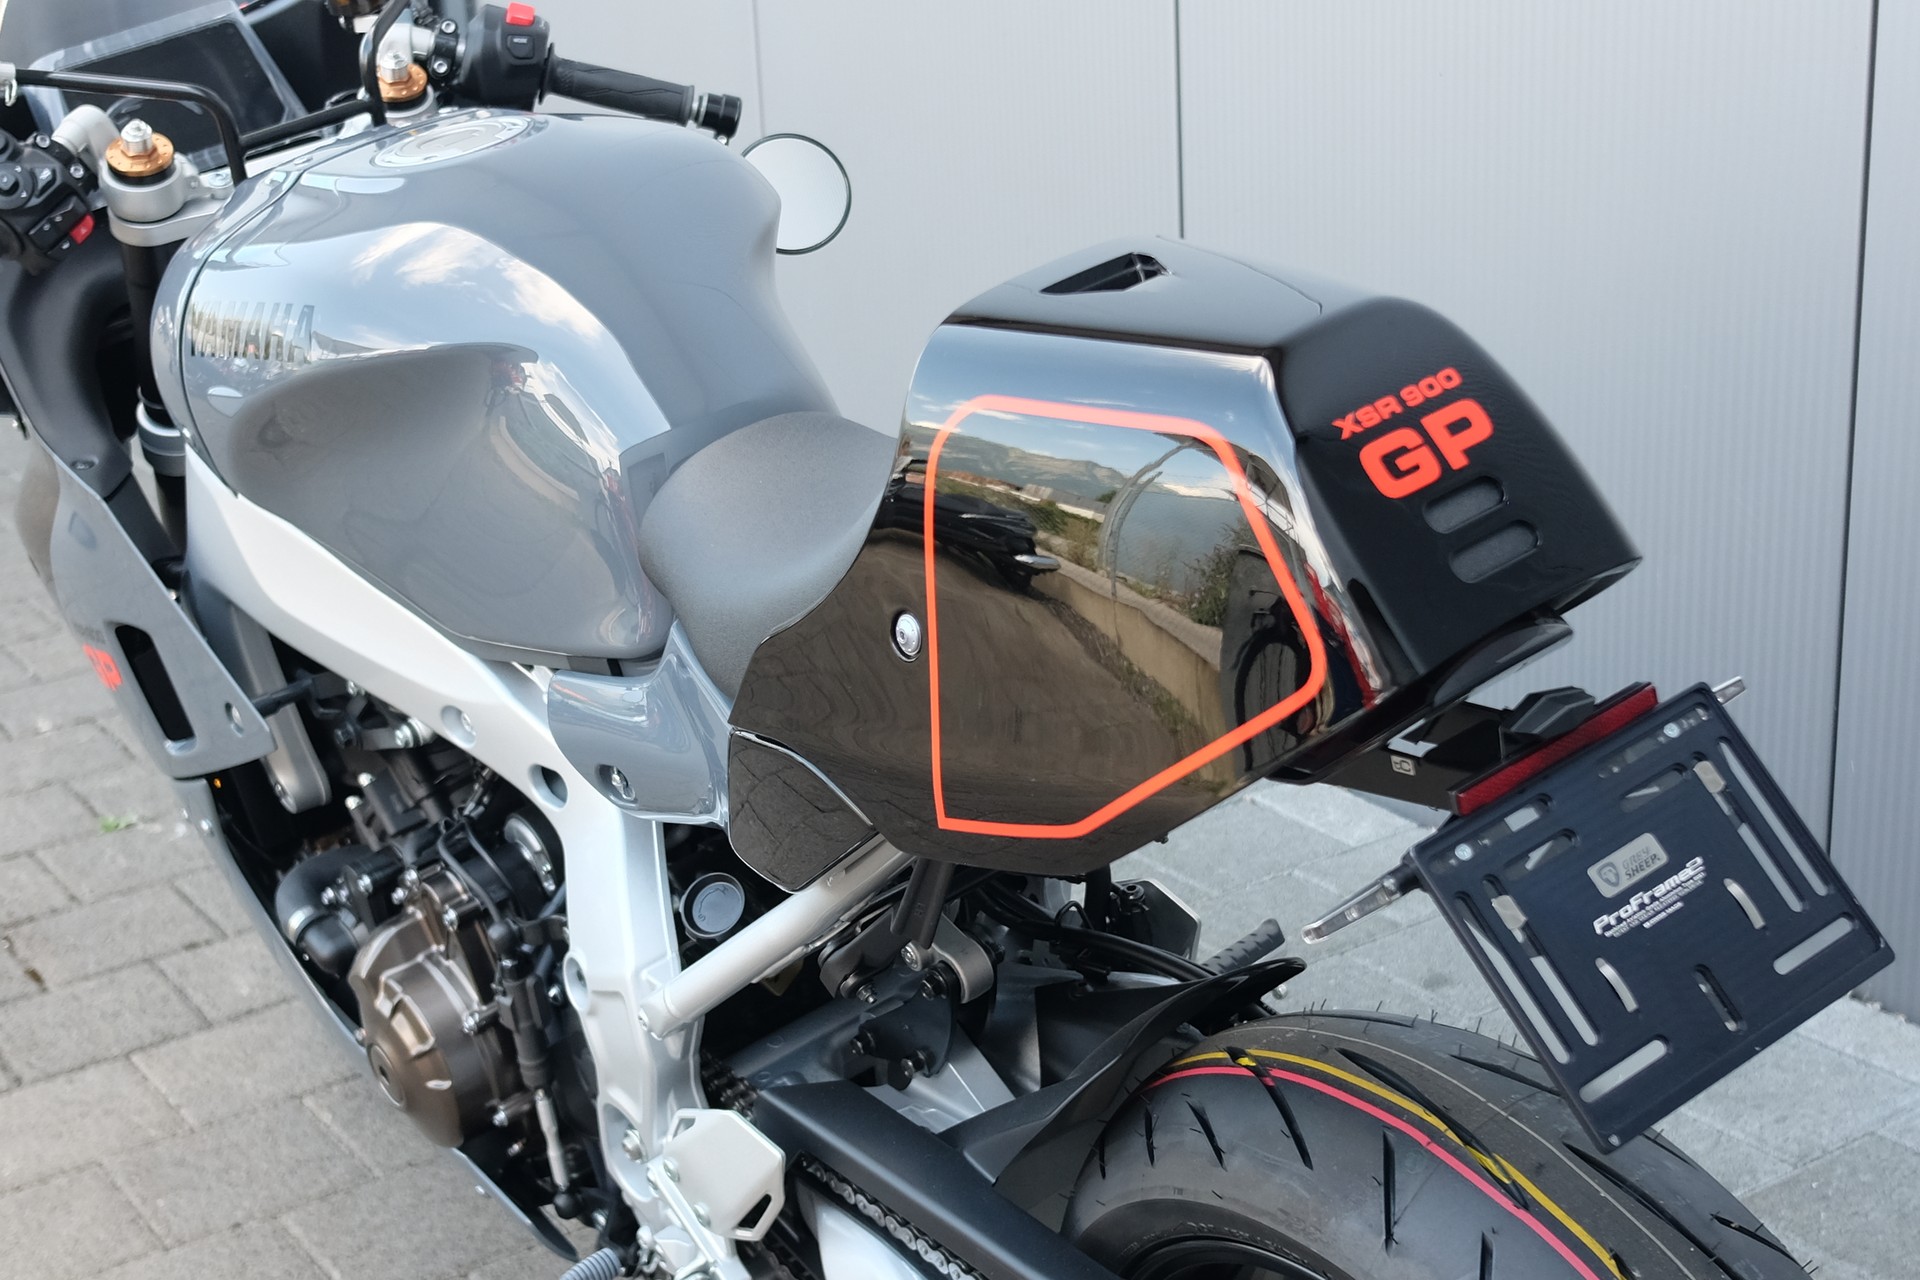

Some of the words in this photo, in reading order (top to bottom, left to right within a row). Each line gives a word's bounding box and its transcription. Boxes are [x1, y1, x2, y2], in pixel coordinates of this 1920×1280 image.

[1331, 394, 1403, 441] XSR
[1399, 366, 1463, 407] 900
[1358, 398, 1494, 499] GP
[1592, 855, 1705, 936] ProFrame2
